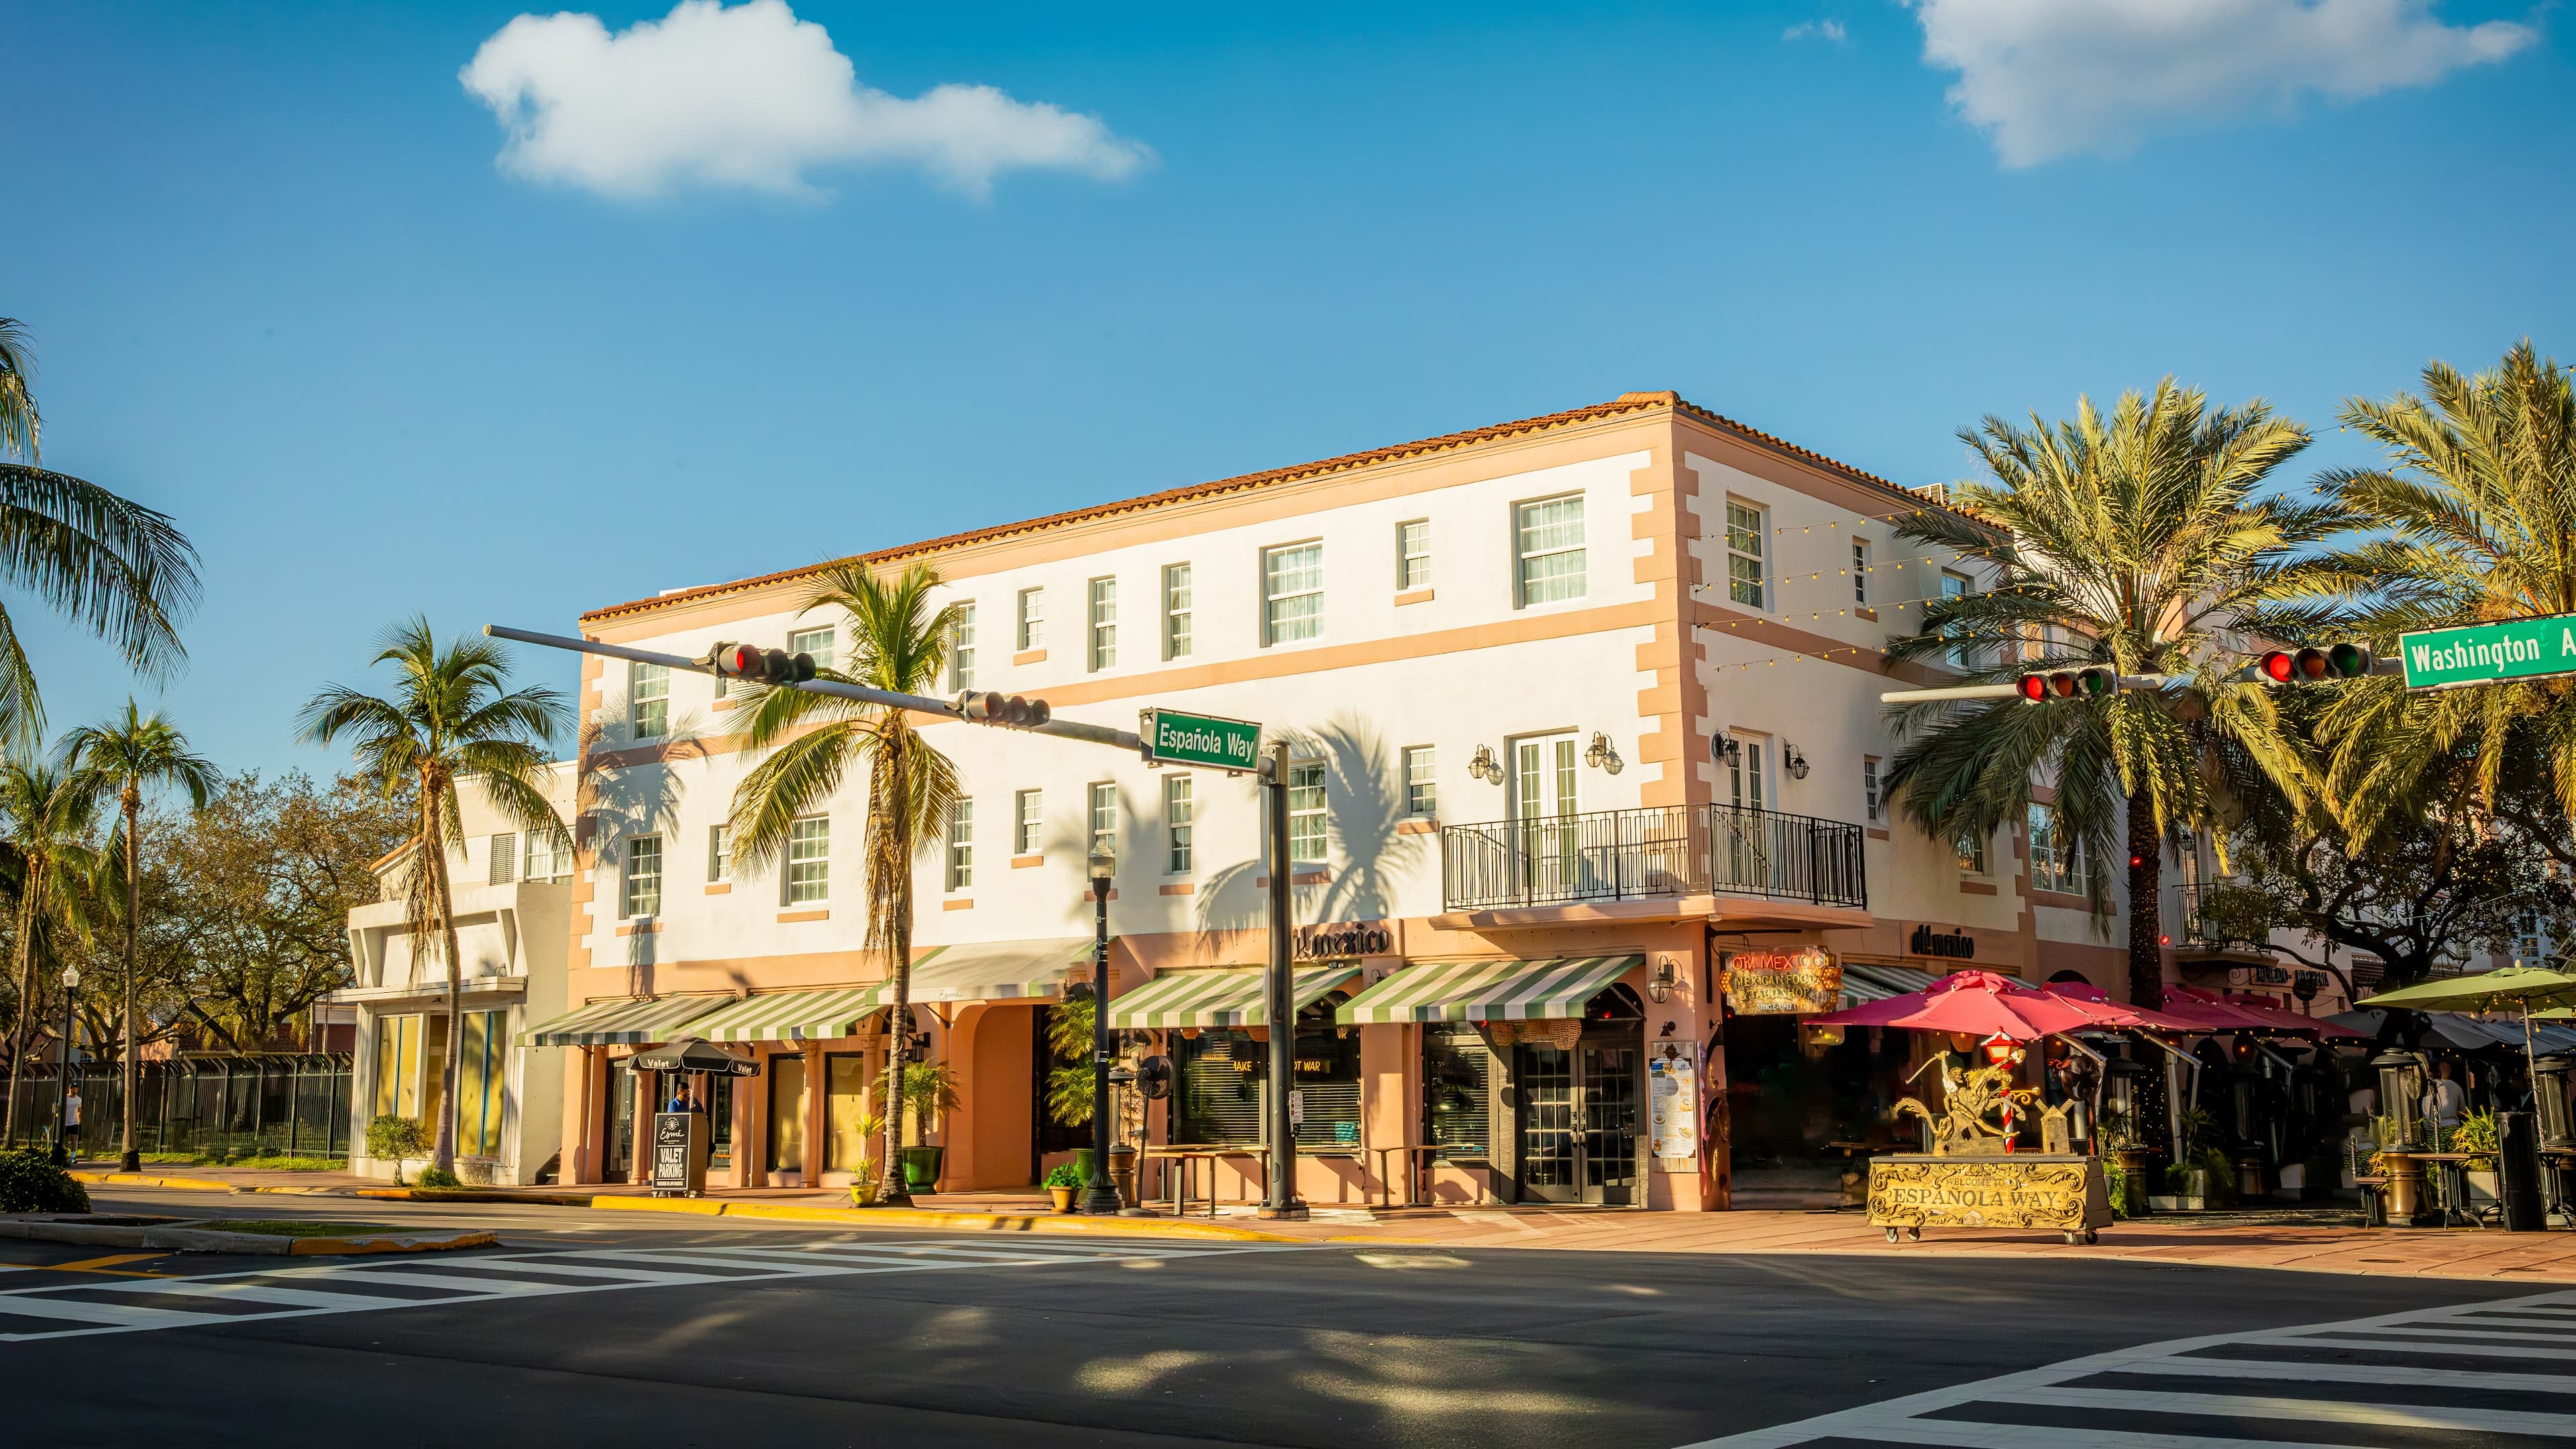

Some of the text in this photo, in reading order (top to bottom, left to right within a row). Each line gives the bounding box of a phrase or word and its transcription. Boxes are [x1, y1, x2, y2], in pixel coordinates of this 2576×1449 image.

[2412, 635, 2540, 673] Washington
[1159, 722, 1254, 763] Española Way
[1734, 975, 1783, 986] MEXICAN
[647, 1059, 669, 1067] Valet
[738, 1063, 752, 1075] Valet
[1303, 1061, 1320, 1071] WAR
[660, 1148, 683, 1163] VALET
[658, 1163, 683, 1178] PARKING
[1946, 1177, 2005, 1187] WELCOME TO
[1892, 1186, 2059, 1208] ESPAÑOLA WAY
